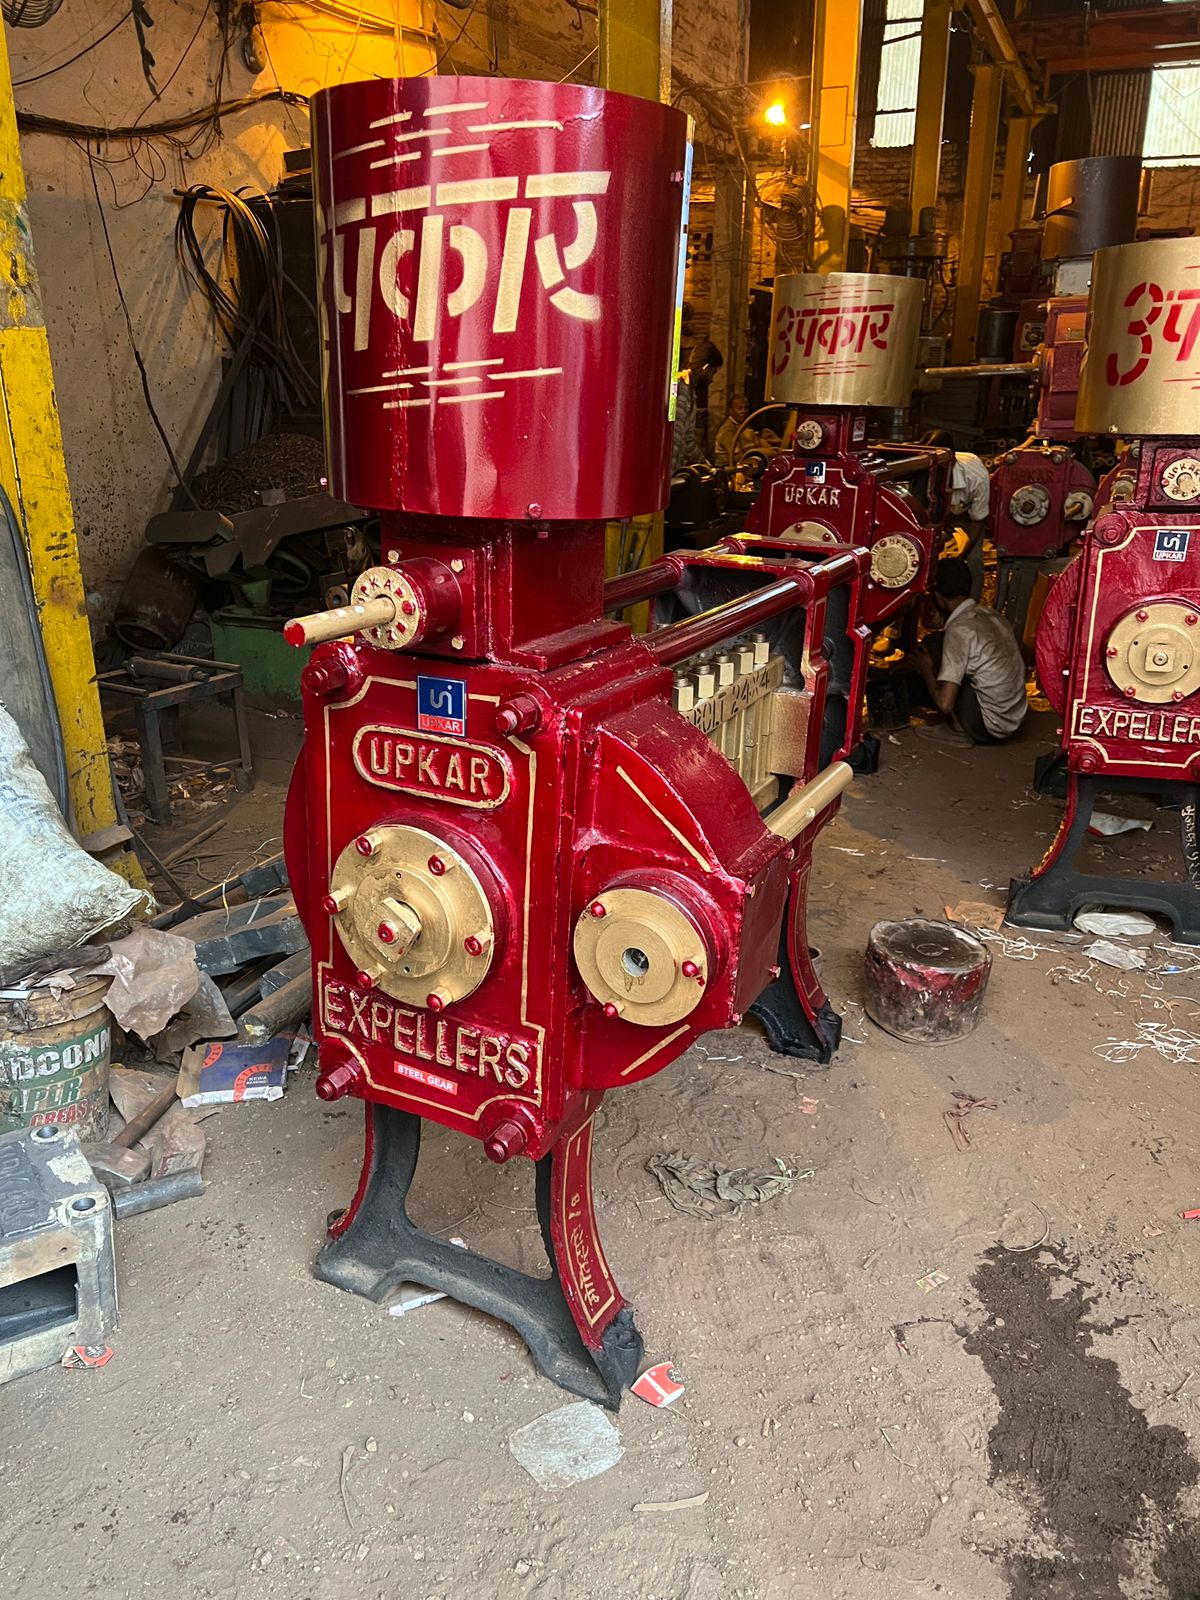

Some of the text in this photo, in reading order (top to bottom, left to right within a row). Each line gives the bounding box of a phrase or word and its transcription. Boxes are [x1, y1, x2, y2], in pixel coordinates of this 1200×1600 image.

[772, 304, 895, 377] उपकार
[784, 486, 841, 508] UPKAR
[1156, 551, 1186, 561] UPKAR
[369, 736, 492, 797] UPKAR
[323, 981, 530, 1090] EXPELLERS
[397, 1064, 454, 1092] STEEL GEAR
